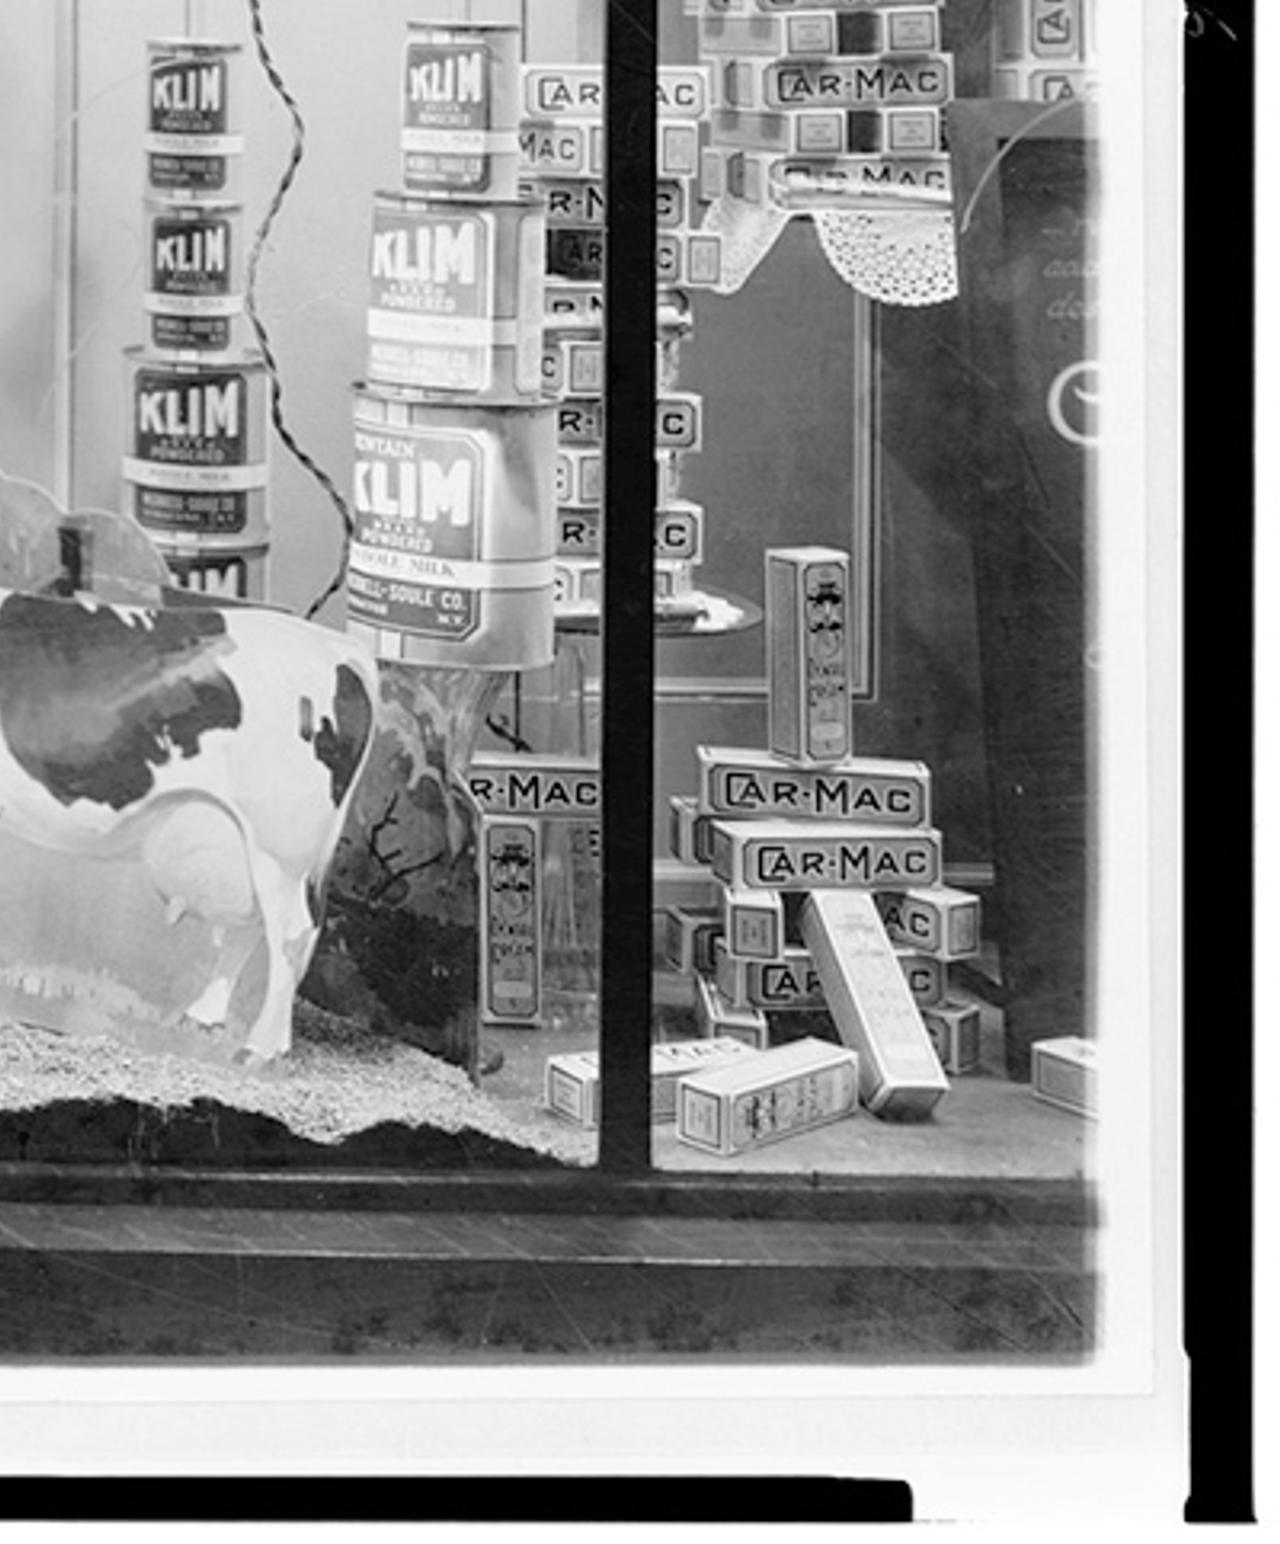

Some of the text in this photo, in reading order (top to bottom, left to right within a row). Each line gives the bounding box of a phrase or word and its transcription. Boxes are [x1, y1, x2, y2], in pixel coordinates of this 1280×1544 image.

[153, 66, 220, 112] KLIM
[409, 51, 482, 103] KLIM
[156, 227, 224, 272] KLIM
[371, 220, 477, 285] KLIM
[140, 381, 238, 437] KLIM
